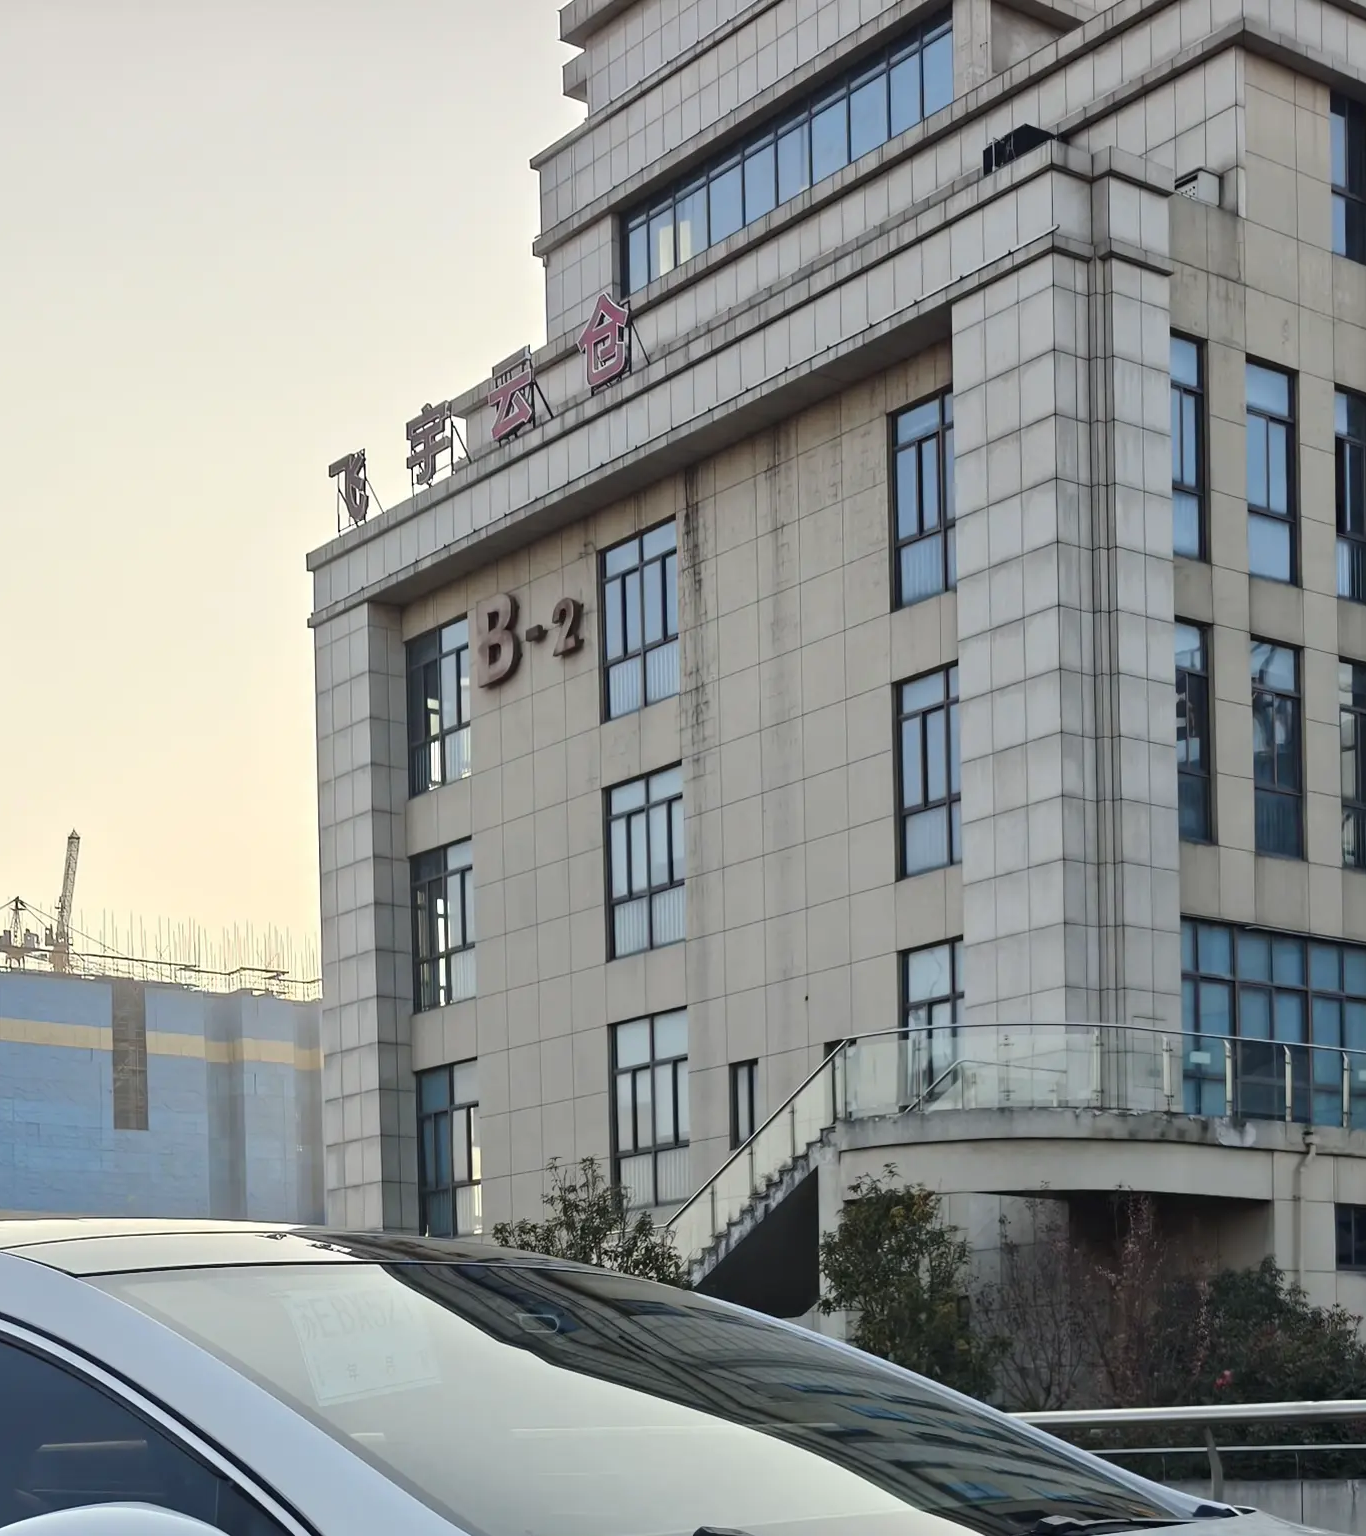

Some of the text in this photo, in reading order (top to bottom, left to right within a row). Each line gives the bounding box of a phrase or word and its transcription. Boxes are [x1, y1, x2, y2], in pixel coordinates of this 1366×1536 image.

[329, 292, 628, 521] 飞宇云仓
[476, 593, 584, 689] B-2
